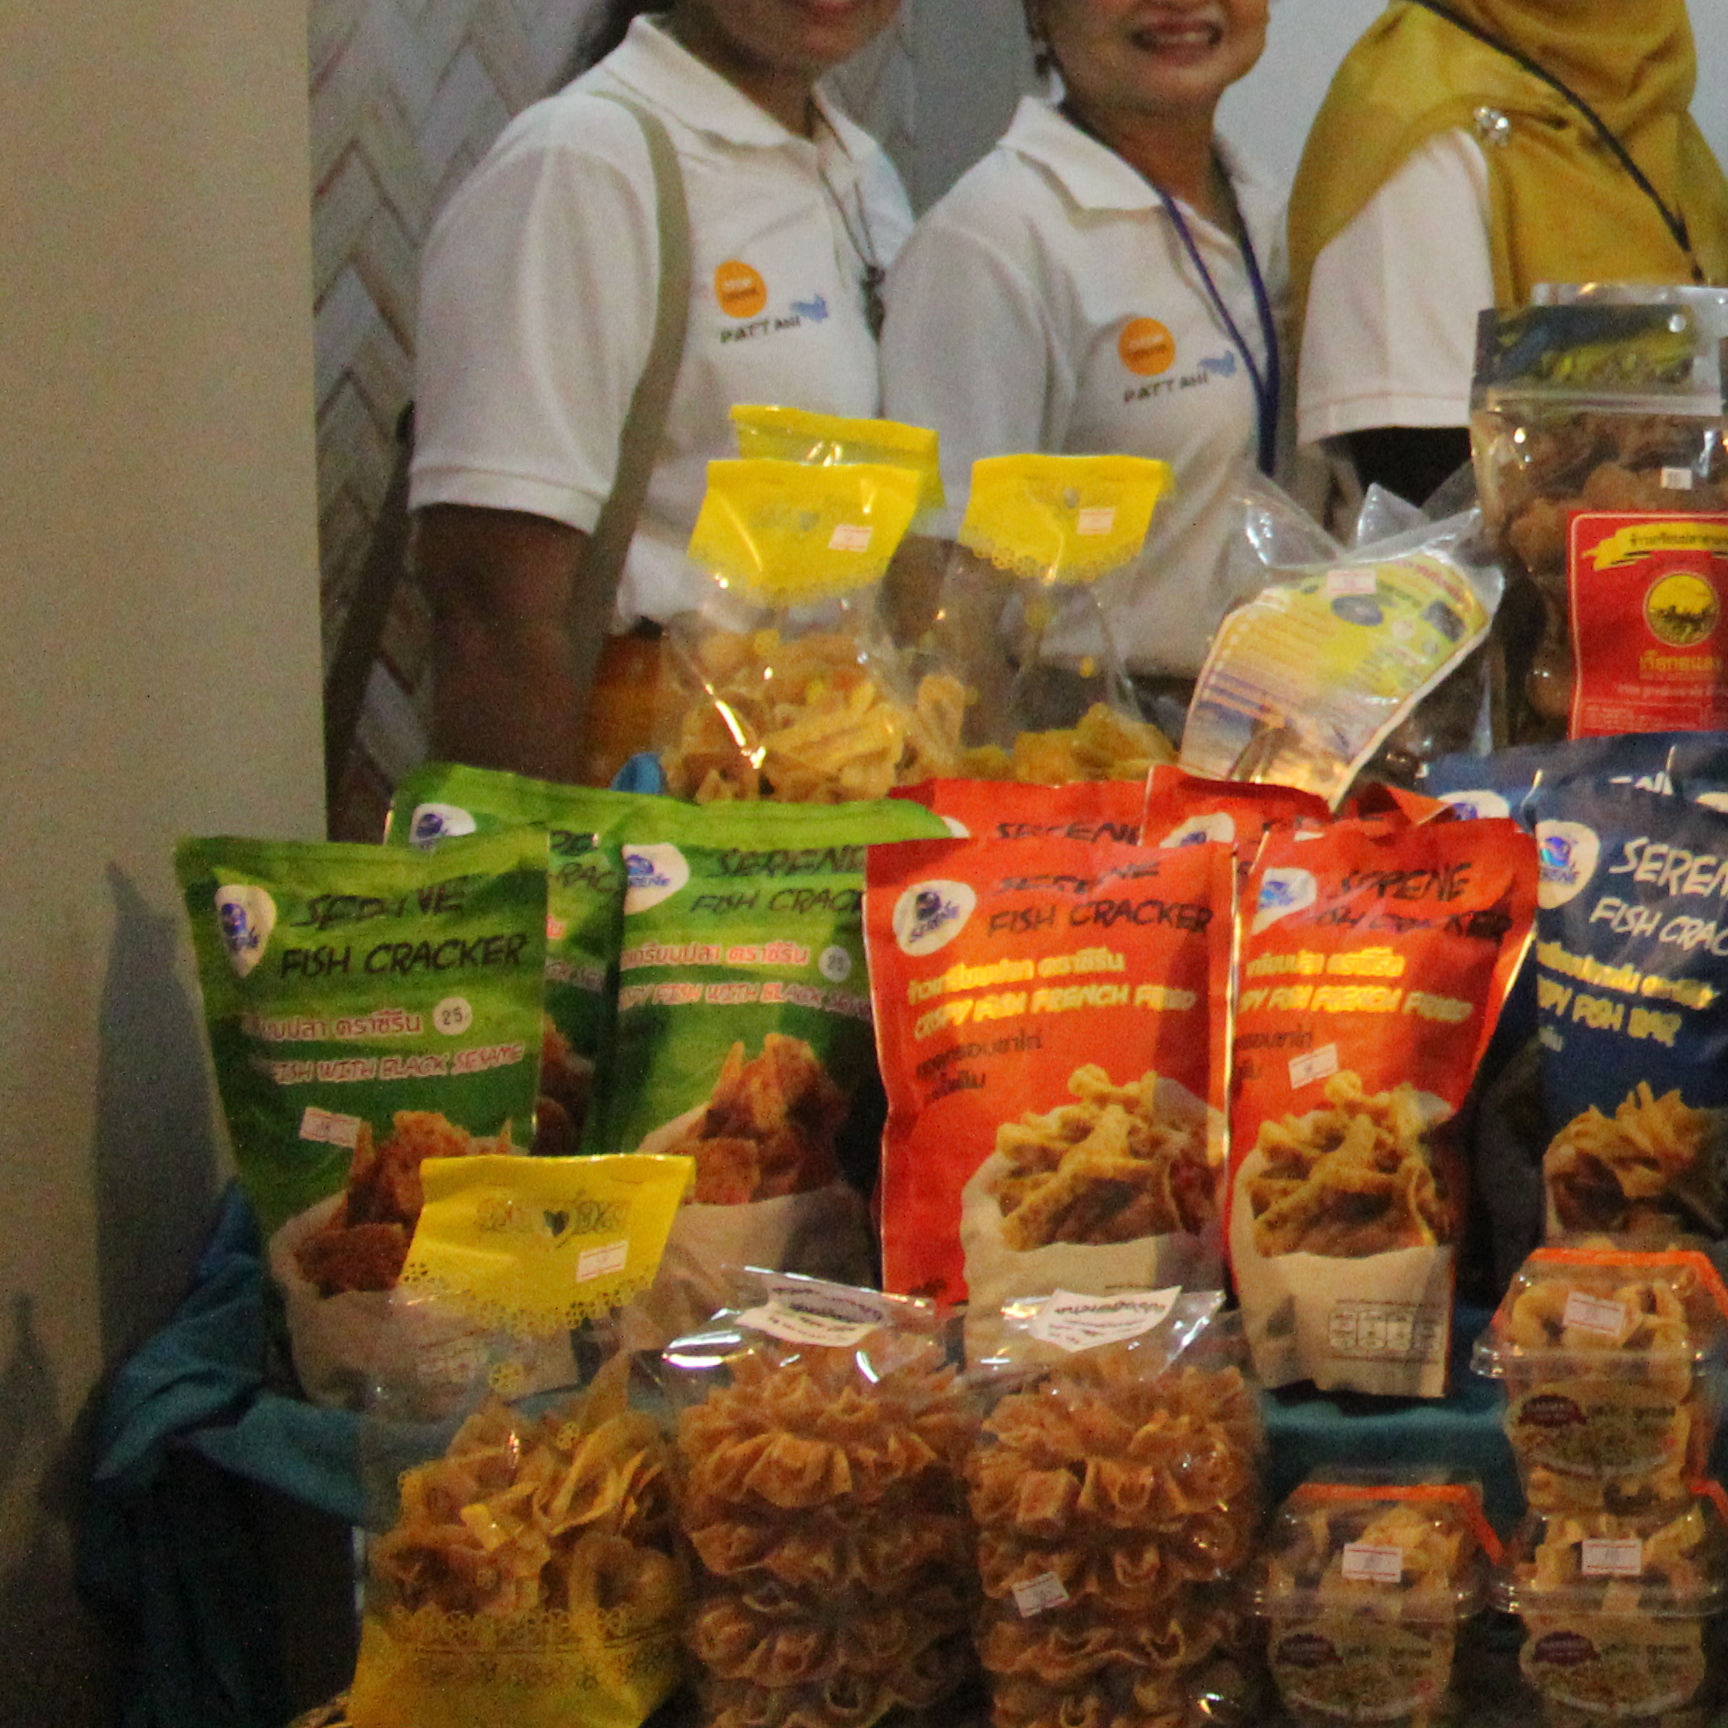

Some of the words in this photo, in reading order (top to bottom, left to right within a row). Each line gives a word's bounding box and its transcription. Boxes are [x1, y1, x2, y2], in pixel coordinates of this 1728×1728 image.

[720, 314, 802, 344] PATTANI
[1123, 372, 1209, 404] PATTANI
[987, 904, 1056, 937] FISH
[1068, 899, 1214, 934] CRACKER
[1588, 896, 1662, 937] FISH
[281, 945, 350, 977] FISH
[364, 933, 528, 974] CRACKER
[652, 983, 702, 1005] FISH
[704, 983, 759, 1005] WITH
[760, 982, 823, 1009] BLACK
[1031, 984, 1130, 1013] FRENCH
[442, 1009, 464, 1027] 25
[316, 1057, 377, 1082] WITH
[379, 1055, 448, 1081] BLACK
